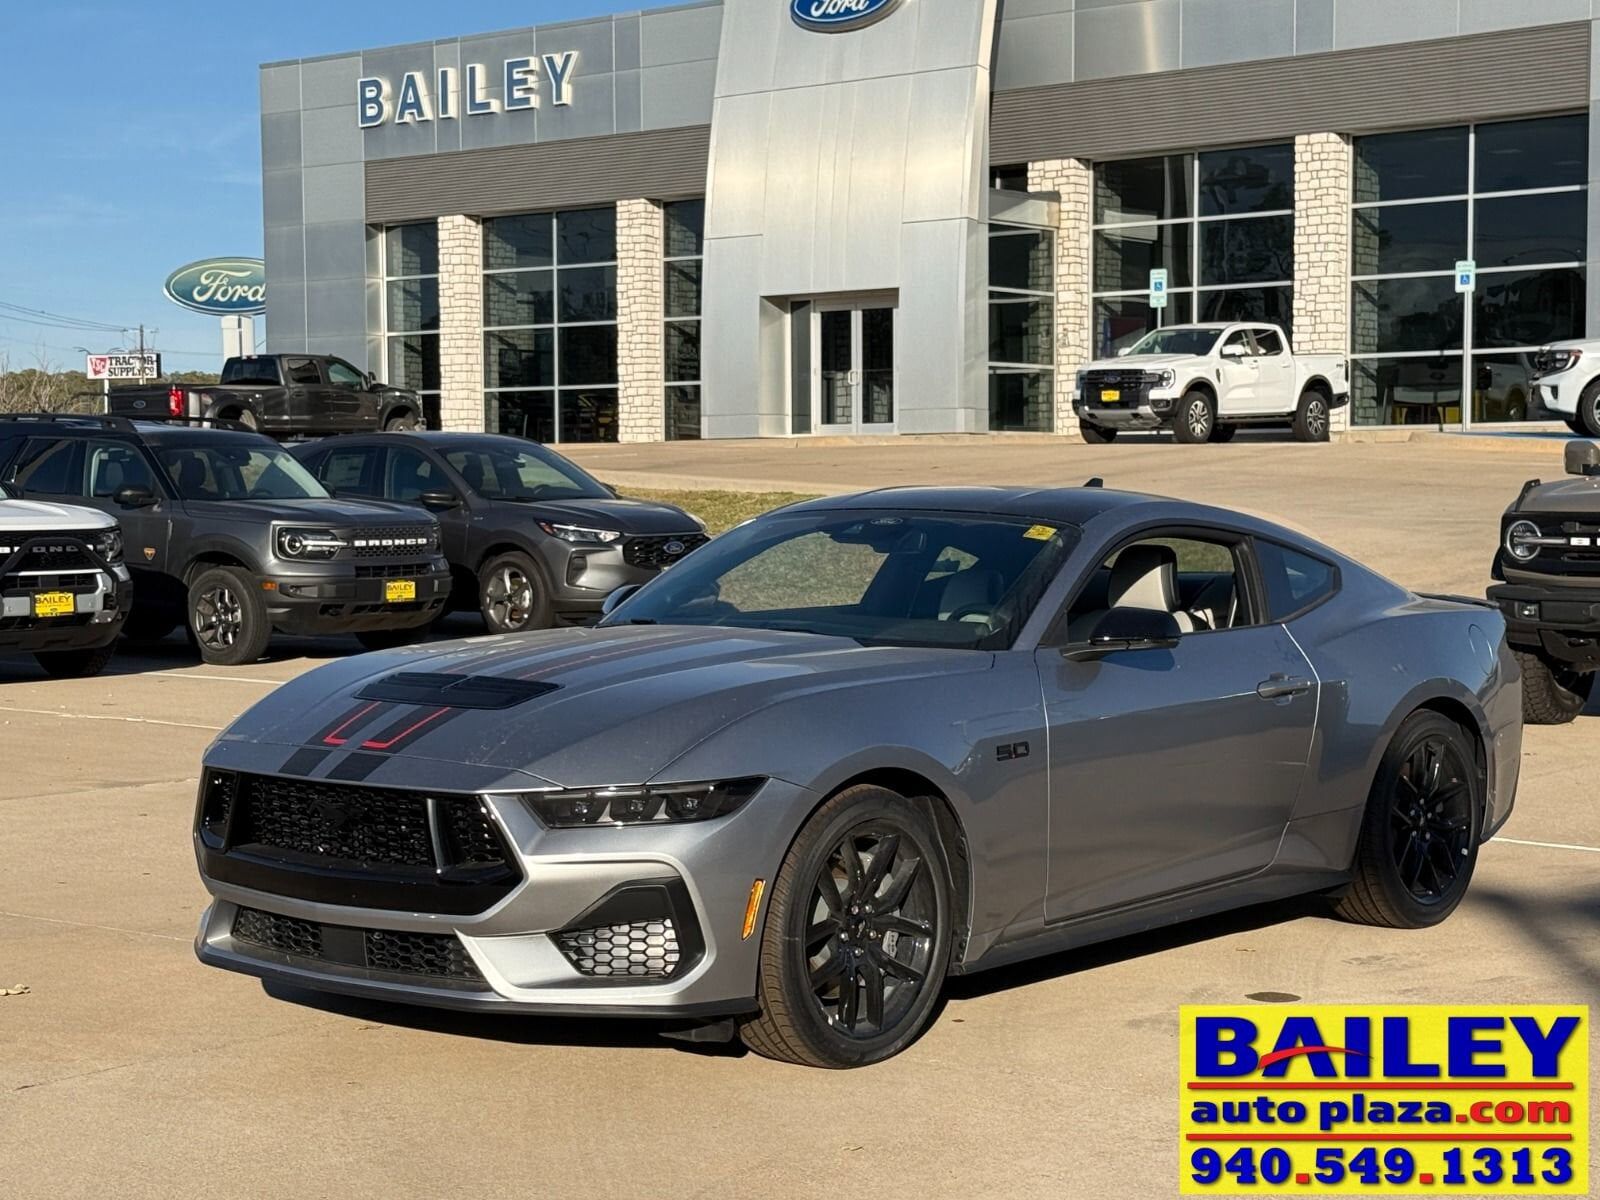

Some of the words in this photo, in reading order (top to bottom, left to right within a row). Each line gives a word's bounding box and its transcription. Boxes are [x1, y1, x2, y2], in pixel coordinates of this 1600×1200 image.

[357, 51, 579, 128] BAILEY
[353, 538, 427, 547] BRONCO
[35, 595, 72, 605] BAILEY
